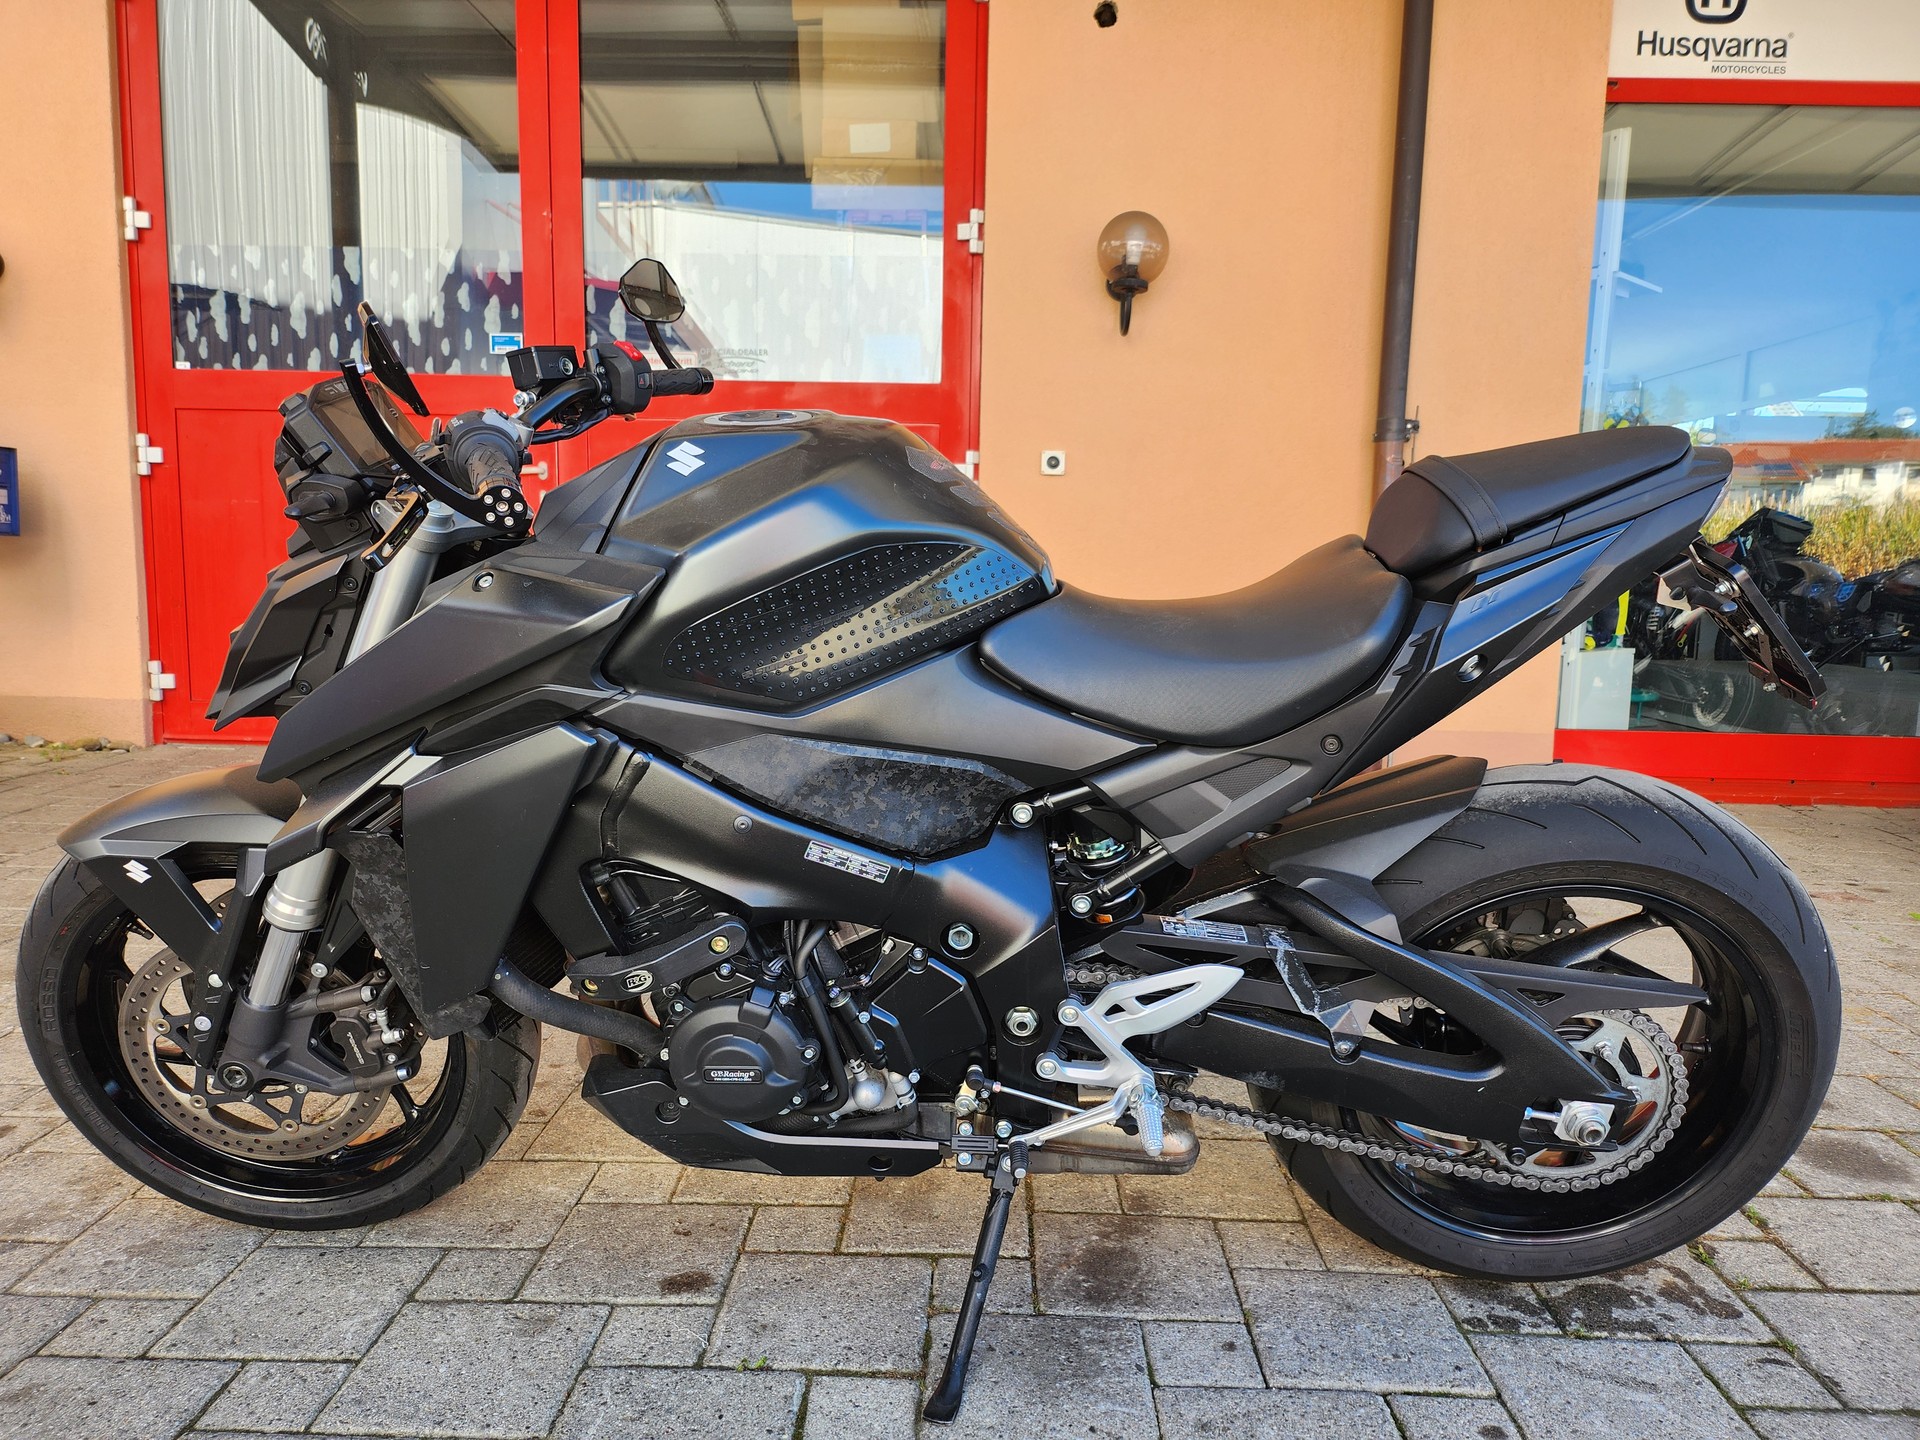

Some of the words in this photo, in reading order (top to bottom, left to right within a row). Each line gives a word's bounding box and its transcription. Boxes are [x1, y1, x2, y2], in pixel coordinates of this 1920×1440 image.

[1636, 30, 1788, 62] Husqvarna
[1711, 65, 1786, 75] MOTORCYCLES
[700, 348, 736, 356] OFCIAL
[738, 348, 768, 356] DEALER
[627, 975, 647, 988] R&G
[41, 967, 59, 1032] ROSSO
